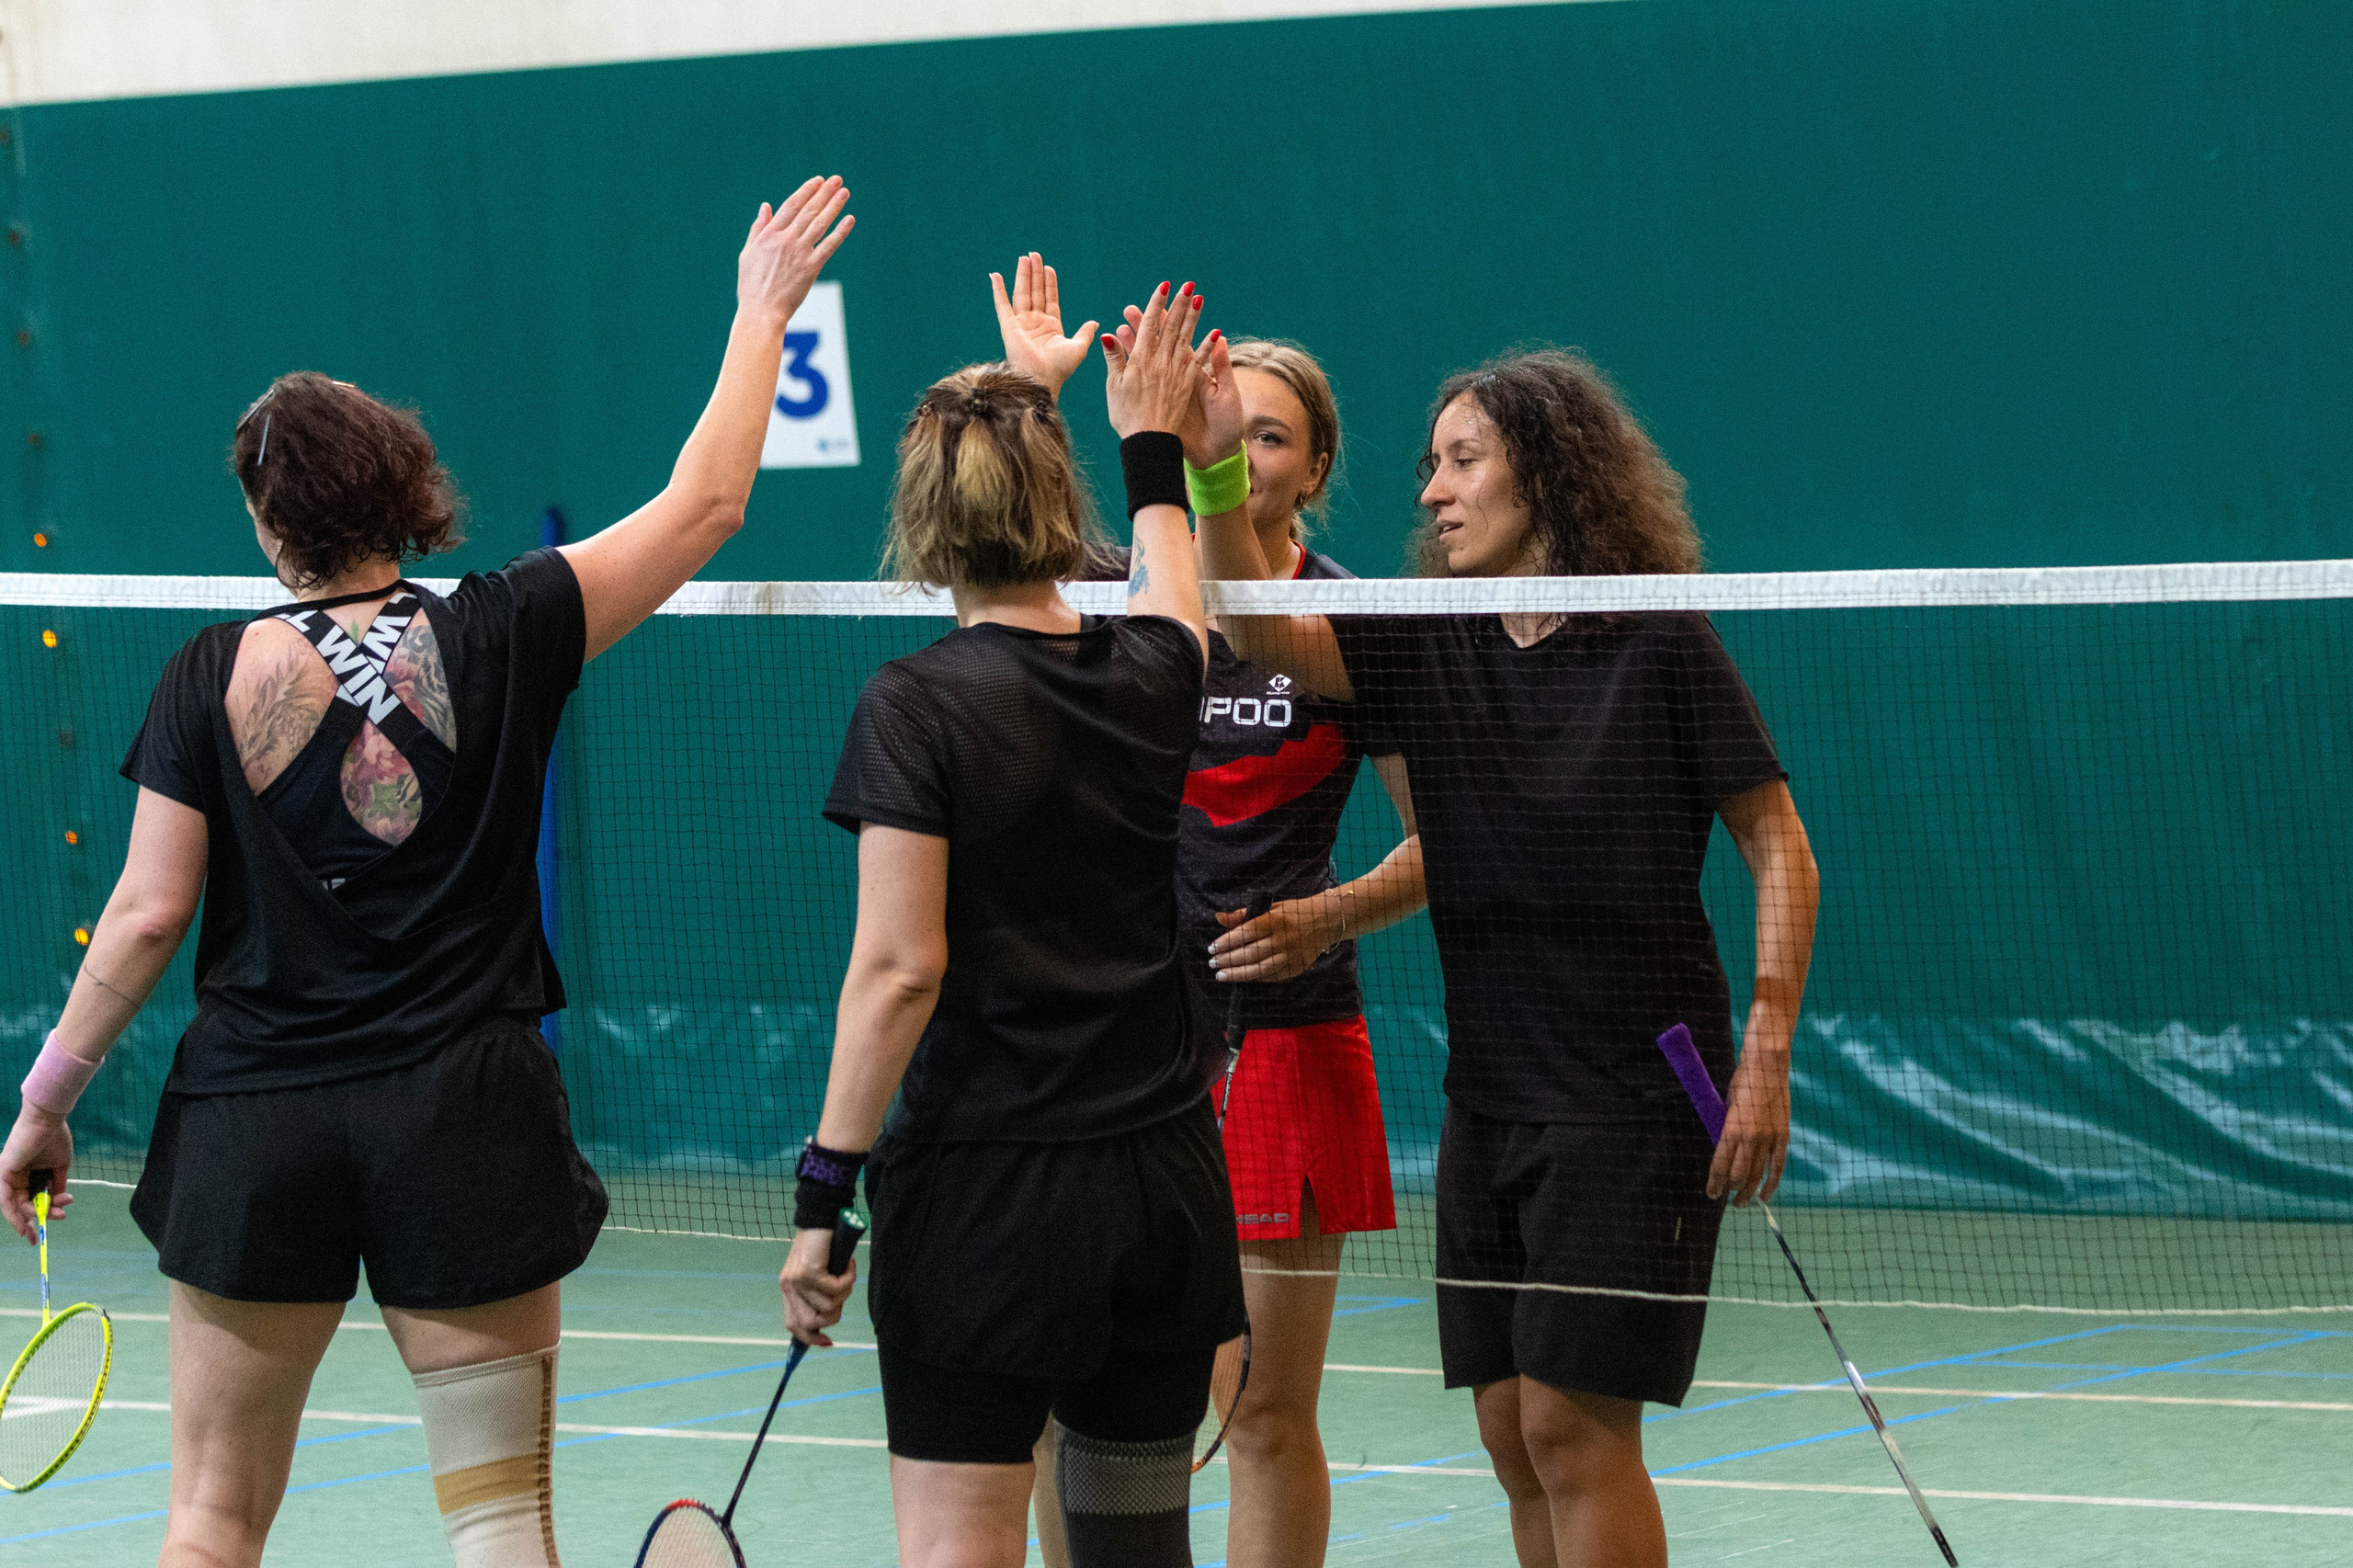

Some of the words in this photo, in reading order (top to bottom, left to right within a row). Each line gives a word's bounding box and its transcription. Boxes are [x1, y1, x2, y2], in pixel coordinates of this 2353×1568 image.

[777, 331, 829, 419] 3
[316, 625, 402, 725] WIN
[1199, 697, 1292, 727] POO
